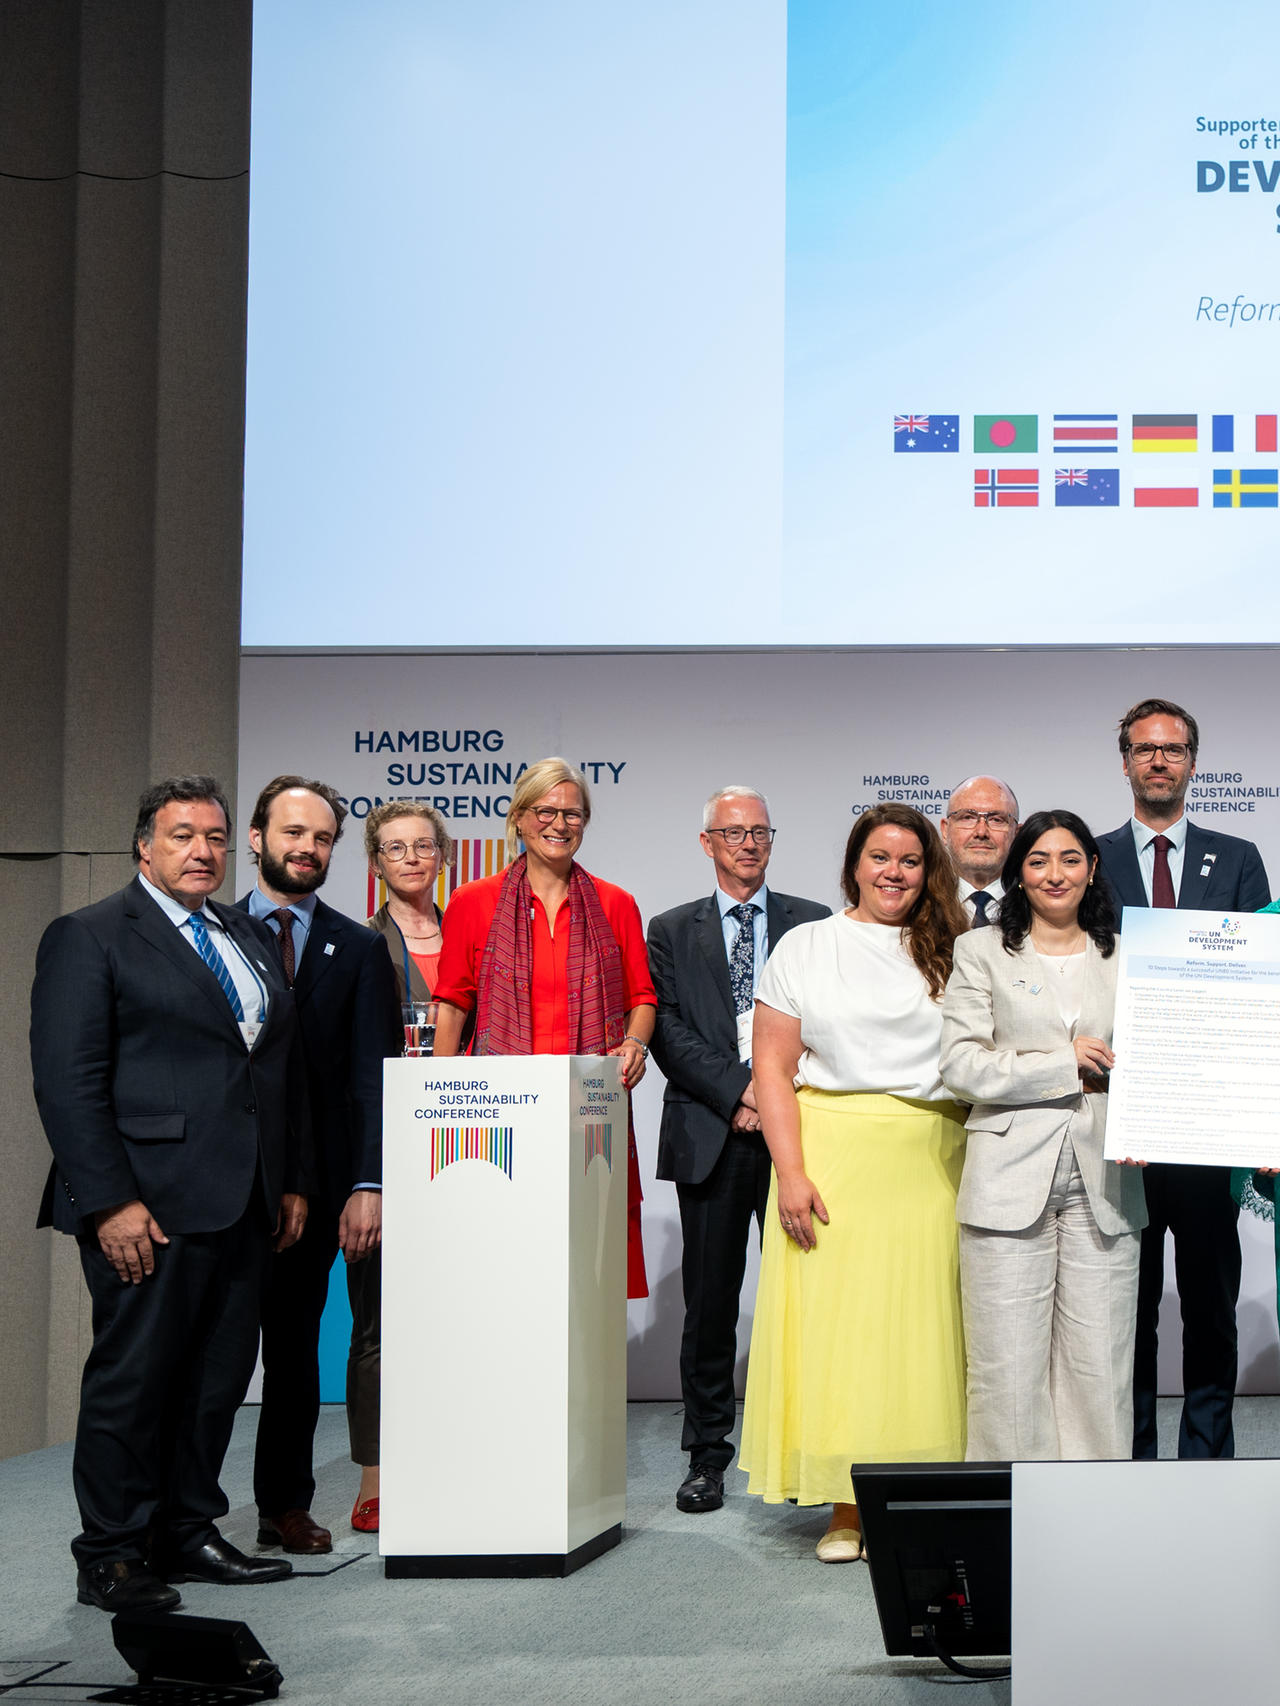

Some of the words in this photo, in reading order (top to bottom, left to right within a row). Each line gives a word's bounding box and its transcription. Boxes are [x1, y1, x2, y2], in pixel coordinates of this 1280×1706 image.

[1239, 134, 1258, 149] of
[355, 730, 504, 753] HAMBURG
[386, 761, 627, 786] SUSTAINAITY
[1189, 773, 1243, 783] MBURG
[863, 775, 930, 786] HAMBURG
[877, 789, 951, 801] SUSTAINAB
[1186, 801, 1256, 812] NFERENCE
[1189, 936, 1247, 945] DEVELOPMENT
[425, 1081, 489, 1091] HAMBURG
[439, 1094, 539, 1105] SUSTAINABILITY
[414, 1108, 500, 1119] CONFERENCE
